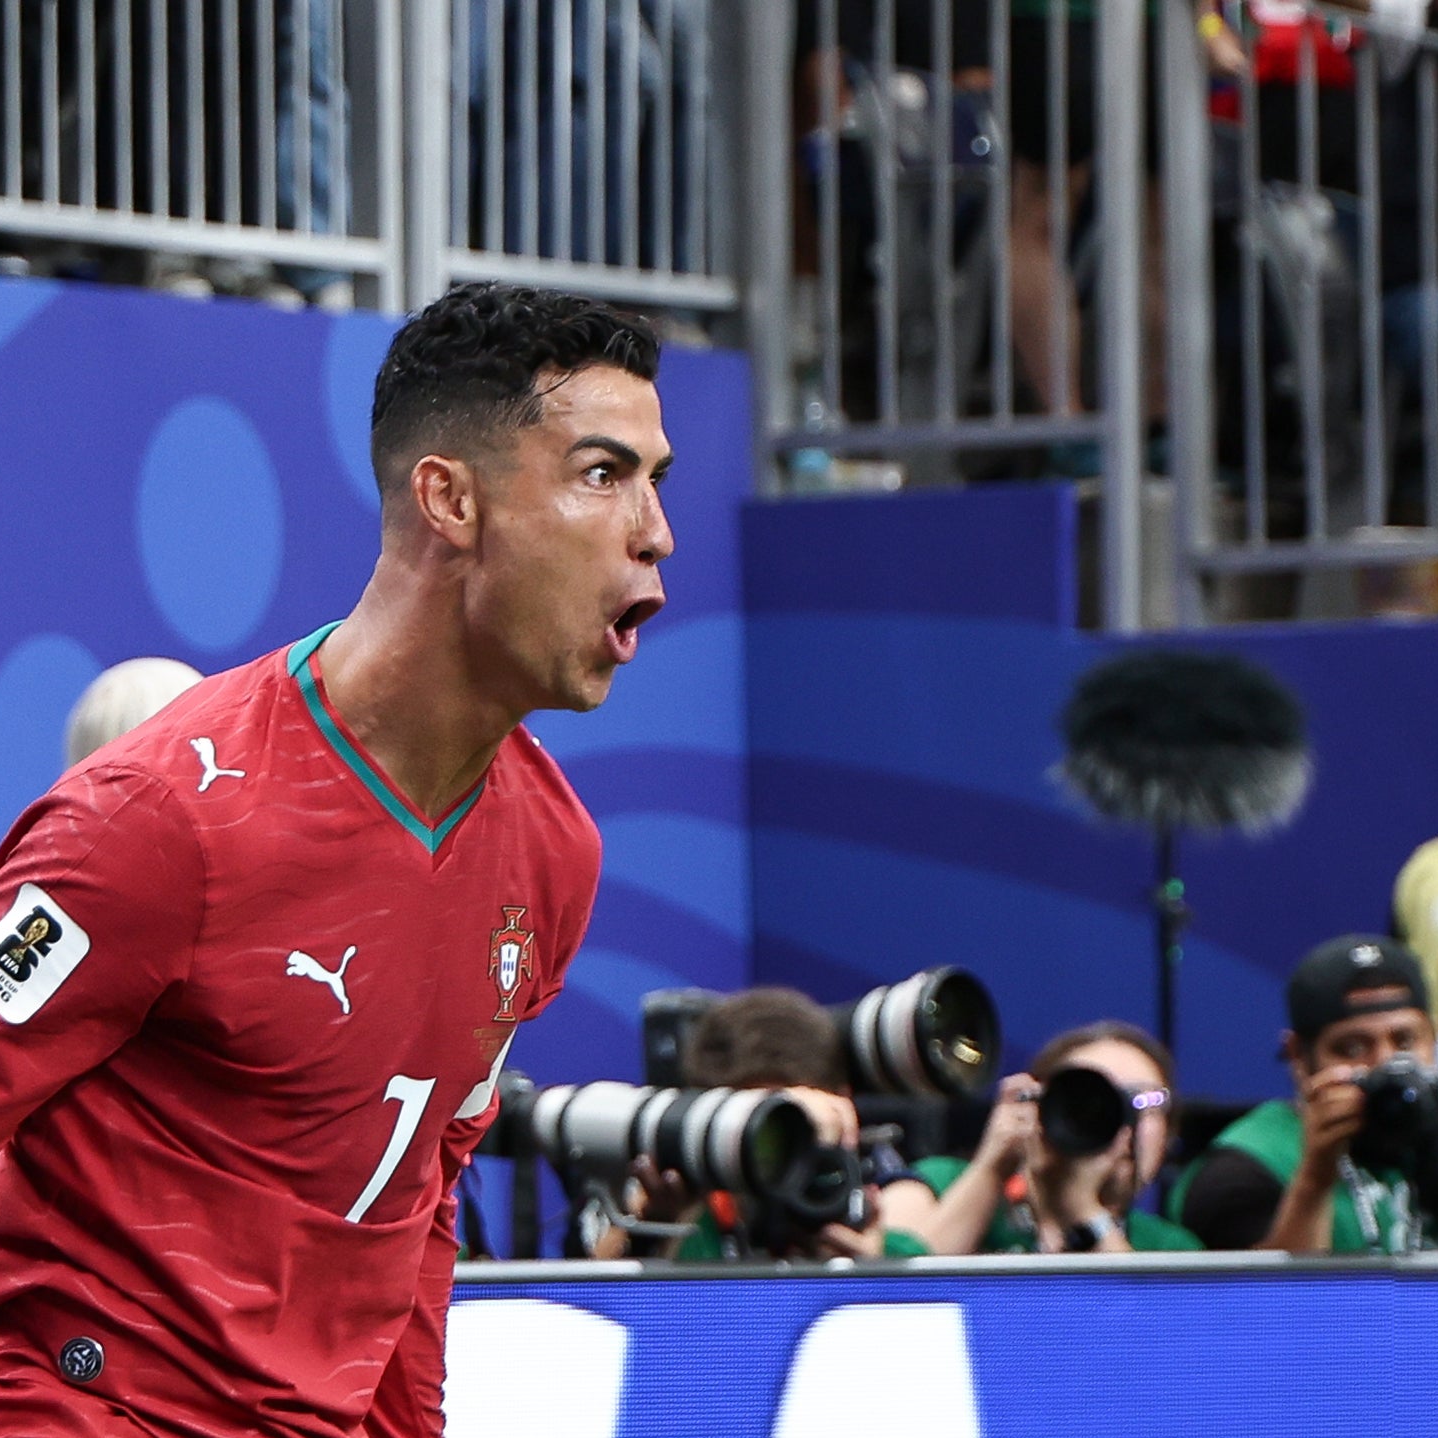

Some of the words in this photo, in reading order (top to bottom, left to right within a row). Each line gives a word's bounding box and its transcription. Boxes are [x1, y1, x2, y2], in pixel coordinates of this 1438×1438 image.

[0, 953, 21, 976] FIFA
[4, 980, 19, 994] CUP
[344, 1074, 437, 1224] 7
